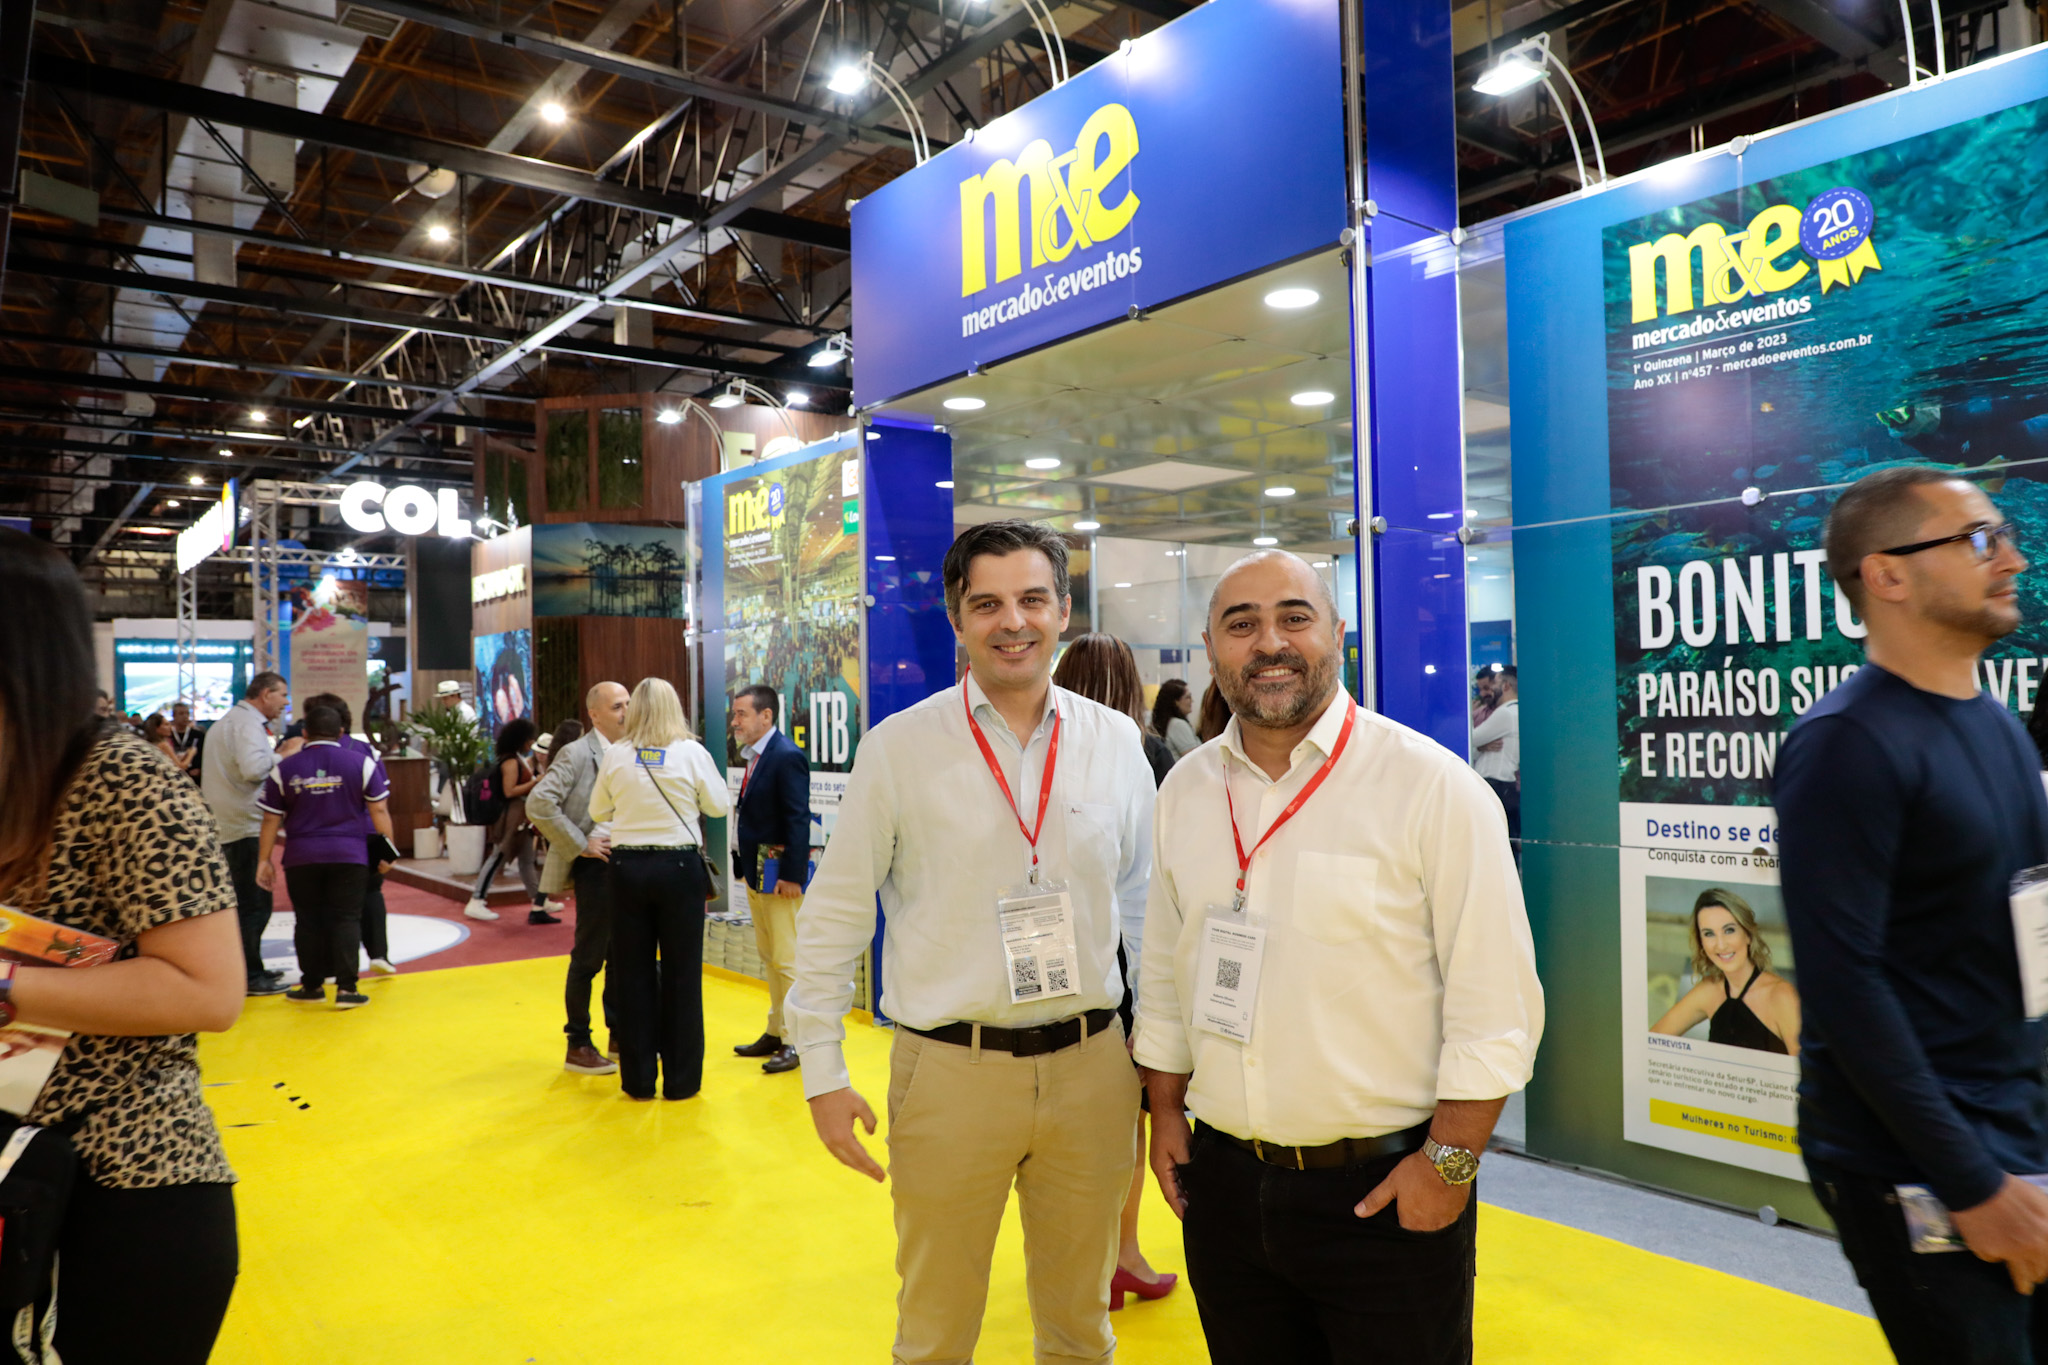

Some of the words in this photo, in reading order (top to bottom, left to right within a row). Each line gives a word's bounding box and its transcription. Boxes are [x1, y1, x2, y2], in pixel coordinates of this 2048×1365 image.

[960, 103, 1141, 298] m&e
[1813, 198, 1855, 238] 20
[1822, 226, 1859, 251] ANOS
[1629, 204, 1810, 324] m&e
[962, 247, 1142, 338] mercado&eventos
[1632, 296, 1812, 350] mercado&eventos
[1634, 378, 1654, 390] Ano
[1657, 373, 1672, 386] XX
[1723, 334, 1873, 373] mercadoeeventos.com.br
[1644, 355, 1692, 373] Quinzena
[1702, 346, 1735, 361] Março
[1739, 341, 1754, 353] de
[1757, 333, 1787, 349] 2023
[340, 481, 471, 537] COL
[1638, 656, 1780, 718] PARAÍSO
[810, 691, 849, 764] ITB
[1640, 732, 1657, 777] E
[1666, 732, 1788, 779] RECON
[1647, 819, 1721, 840] Destino
[1728, 826, 1750, 842] se
[1648, 849, 1705, 864] Conquista
[1711, 855, 1737, 866] com
[1741, 857, 1748, 867] a
[1648, 1036, 1692, 1051] ENTREVISTA
[1648, 1059, 1681, 1071] Secretária
[1682, 1066, 1714, 1078] executiva
[1716, 1072, 1725, 1080] da
[1760, 1080, 1788, 1091] Luciane
[1648, 1068, 1673, 1078] cenário
[1673, 1072, 1702, 1084] turístico
[1703, 1078, 1713, 1086] do
[1714, 1080, 1738, 1091] estado
[1746, 1086, 1767, 1097] revela
[1769, 1090, 1793, 1101] planos
[1648, 1076, 1660, 1085] que
[1662, 1078, 1672, 1086] vai
[1674, 1082, 1704, 1093] enfrentar
[1718, 1090, 1735, 1099] novo
[1682, 1112, 1724, 1129] Mulheres
[1728, 1122, 1740, 1133] no
[1744, 1125, 1787, 1144] Turismo:
